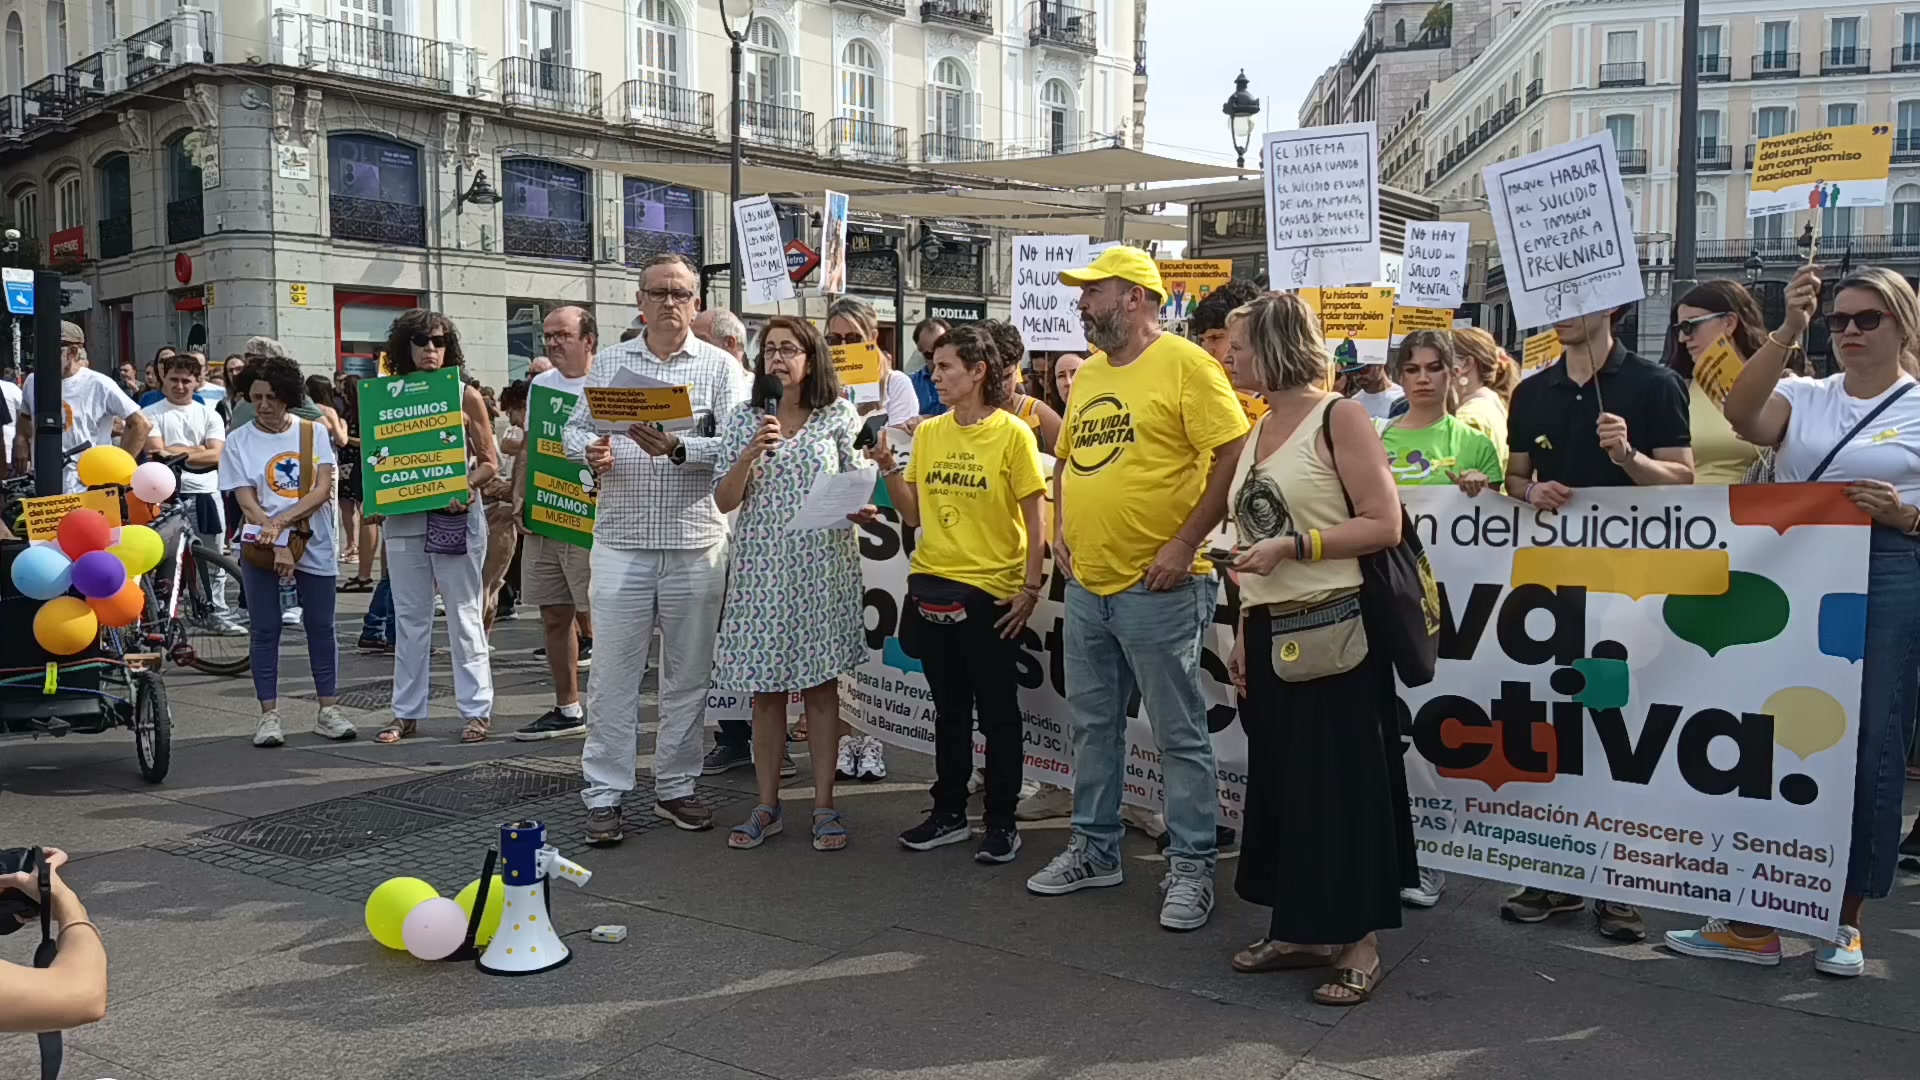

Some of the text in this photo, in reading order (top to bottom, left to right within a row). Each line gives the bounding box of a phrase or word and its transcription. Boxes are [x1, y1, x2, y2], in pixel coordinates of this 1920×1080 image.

[1761, 131, 1833, 150] Prevención
[1275, 142, 1345, 159] EL SISTEMA
[1759, 142, 1833, 161] del suicidio:
[1277, 159, 1359, 177] FRACASA CUANDO
[1758, 151, 1862, 172] un compromiso
[1507, 159, 1601, 196] PORQUE HABLAR
[1756, 166, 1812, 183] nacional
[1277, 182, 1289, 194] EL
[1333, 179, 1344, 190] ES
[1345, 178, 1365, 189] UNA
[1280, 194, 1363, 210] DE LAS PRIMERAS
[1515, 182, 1598, 214] DEL SUICIDIO
[1279, 213, 1310, 227] CAUSAS
[1312, 212, 1325, 223] DE
[1543, 206, 1592, 231] TAMBIÉN
[1279, 229, 1292, 241] EN
[1297, 227, 1313, 239] LOS
[1411, 227, 1456, 242] NO HAY
[1523, 221, 1603, 253] EMPEZAR A
[1020, 244, 1073, 263] NO HAY
[1408, 245, 1442, 259] SALUD
[1160, 261, 1220, 270] Escucha activa.
[1193, 270, 1230, 278] colectiva.
[1408, 263, 1441, 277] SALUD
[1017, 267, 1058, 286] SALUD
[1333, 290, 1368, 299] historia
[1409, 281, 1451, 296] MENTAL
[1019, 291, 1058, 310] SALUD
[1322, 301, 1362, 312] importa.
[931, 307, 979, 320] RODILLA
[1343, 311, 1384, 320] también
[1022, 316, 1072, 333] MENTAL
[1326, 321, 1367, 332] prevenir.
[588, 389, 645, 397] Prevención
[379, 401, 448, 420] SEGUIMOS
[611, 403, 671, 412] compromiso
[380, 415, 448, 436] LUCHANDO
[542, 421, 556, 436] TU
[1080, 413, 1130, 433] TU VIDA
[1074, 428, 1135, 449] IMPORTA
[393, 452, 443, 466] PORQUE
[958, 452, 975, 460] VIDA
[380, 465, 454, 484] CADA VIDA
[932, 461, 984, 472] DEBERÍA SER
[547, 479, 580, 497] JUNTOS
[925, 470, 988, 490] AMARILLA
[398, 481, 446, 498] CUENTA
[27, 496, 81, 508] Prevención
[536, 489, 588, 516] EVITAMOS
[545, 510, 581, 528] MUERTES
[1450, 506, 1519, 548] del
[1530, 504, 1728, 550] Suicidio.
[857, 671, 879, 688] para
[881, 676, 892, 692] la
[847, 683, 872, 705] Agarra
[874, 695, 882, 709] la
[885, 698, 911, 717] Vida
[866, 711, 877, 726] La
[878, 716, 935, 742] Barandilla
[1043, 736, 1062, 751] 3C
[1023, 751, 1070, 775] inestra
[1126, 764, 1144, 778] de
[1465, 797, 1579, 827] Fundación
[1583, 810, 1704, 846] Acrescere
[1711, 833, 1725, 852] y
[1732, 831, 1834, 867] Sendas)
[1463, 820, 1597, 856] Atrapasueños
[1613, 843, 1729, 876] Besarkada
[1752, 863, 1832, 893] Abrazo
[1441, 841, 1465, 858] de
[1467, 844, 1483, 862] la
[1487, 847, 1586, 880] Esperanza
[1602, 867, 1732, 903] Tramuntana
[1751, 889, 1830, 922] Ubuntu
